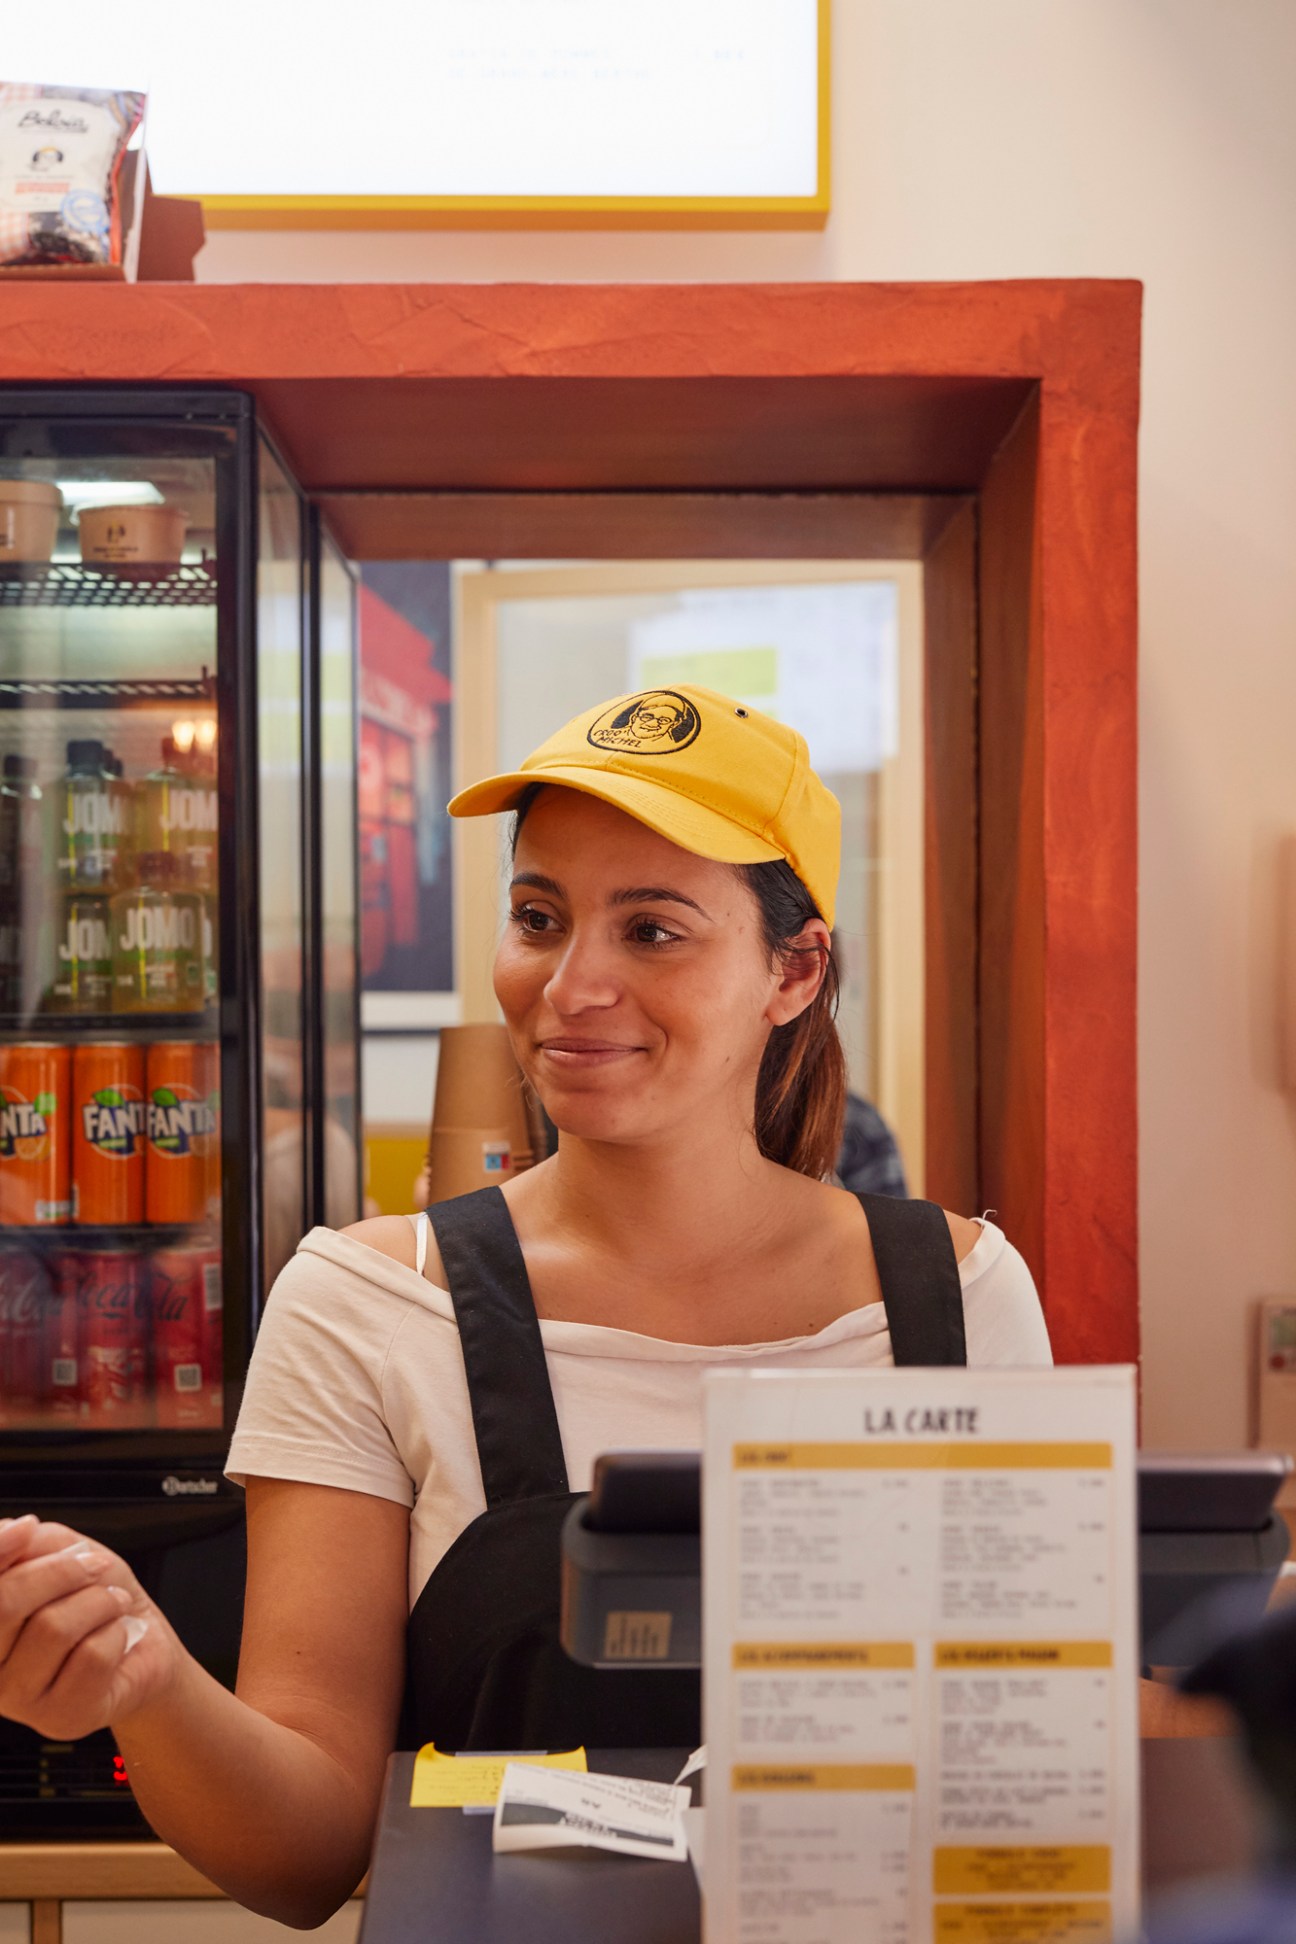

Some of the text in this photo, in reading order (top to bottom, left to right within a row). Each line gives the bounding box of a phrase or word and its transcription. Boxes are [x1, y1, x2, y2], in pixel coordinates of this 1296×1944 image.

[596, 736, 641, 748] MICHEL
[62, 792, 124, 835] JOM
[159, 789, 218, 831] JOM
[119, 906, 195, 951] JOMO
[82, 1101, 146, 1140] FANT
[147, 1101, 216, 1138] FANTA
[864, 1406, 979, 1434] LA CARTE
